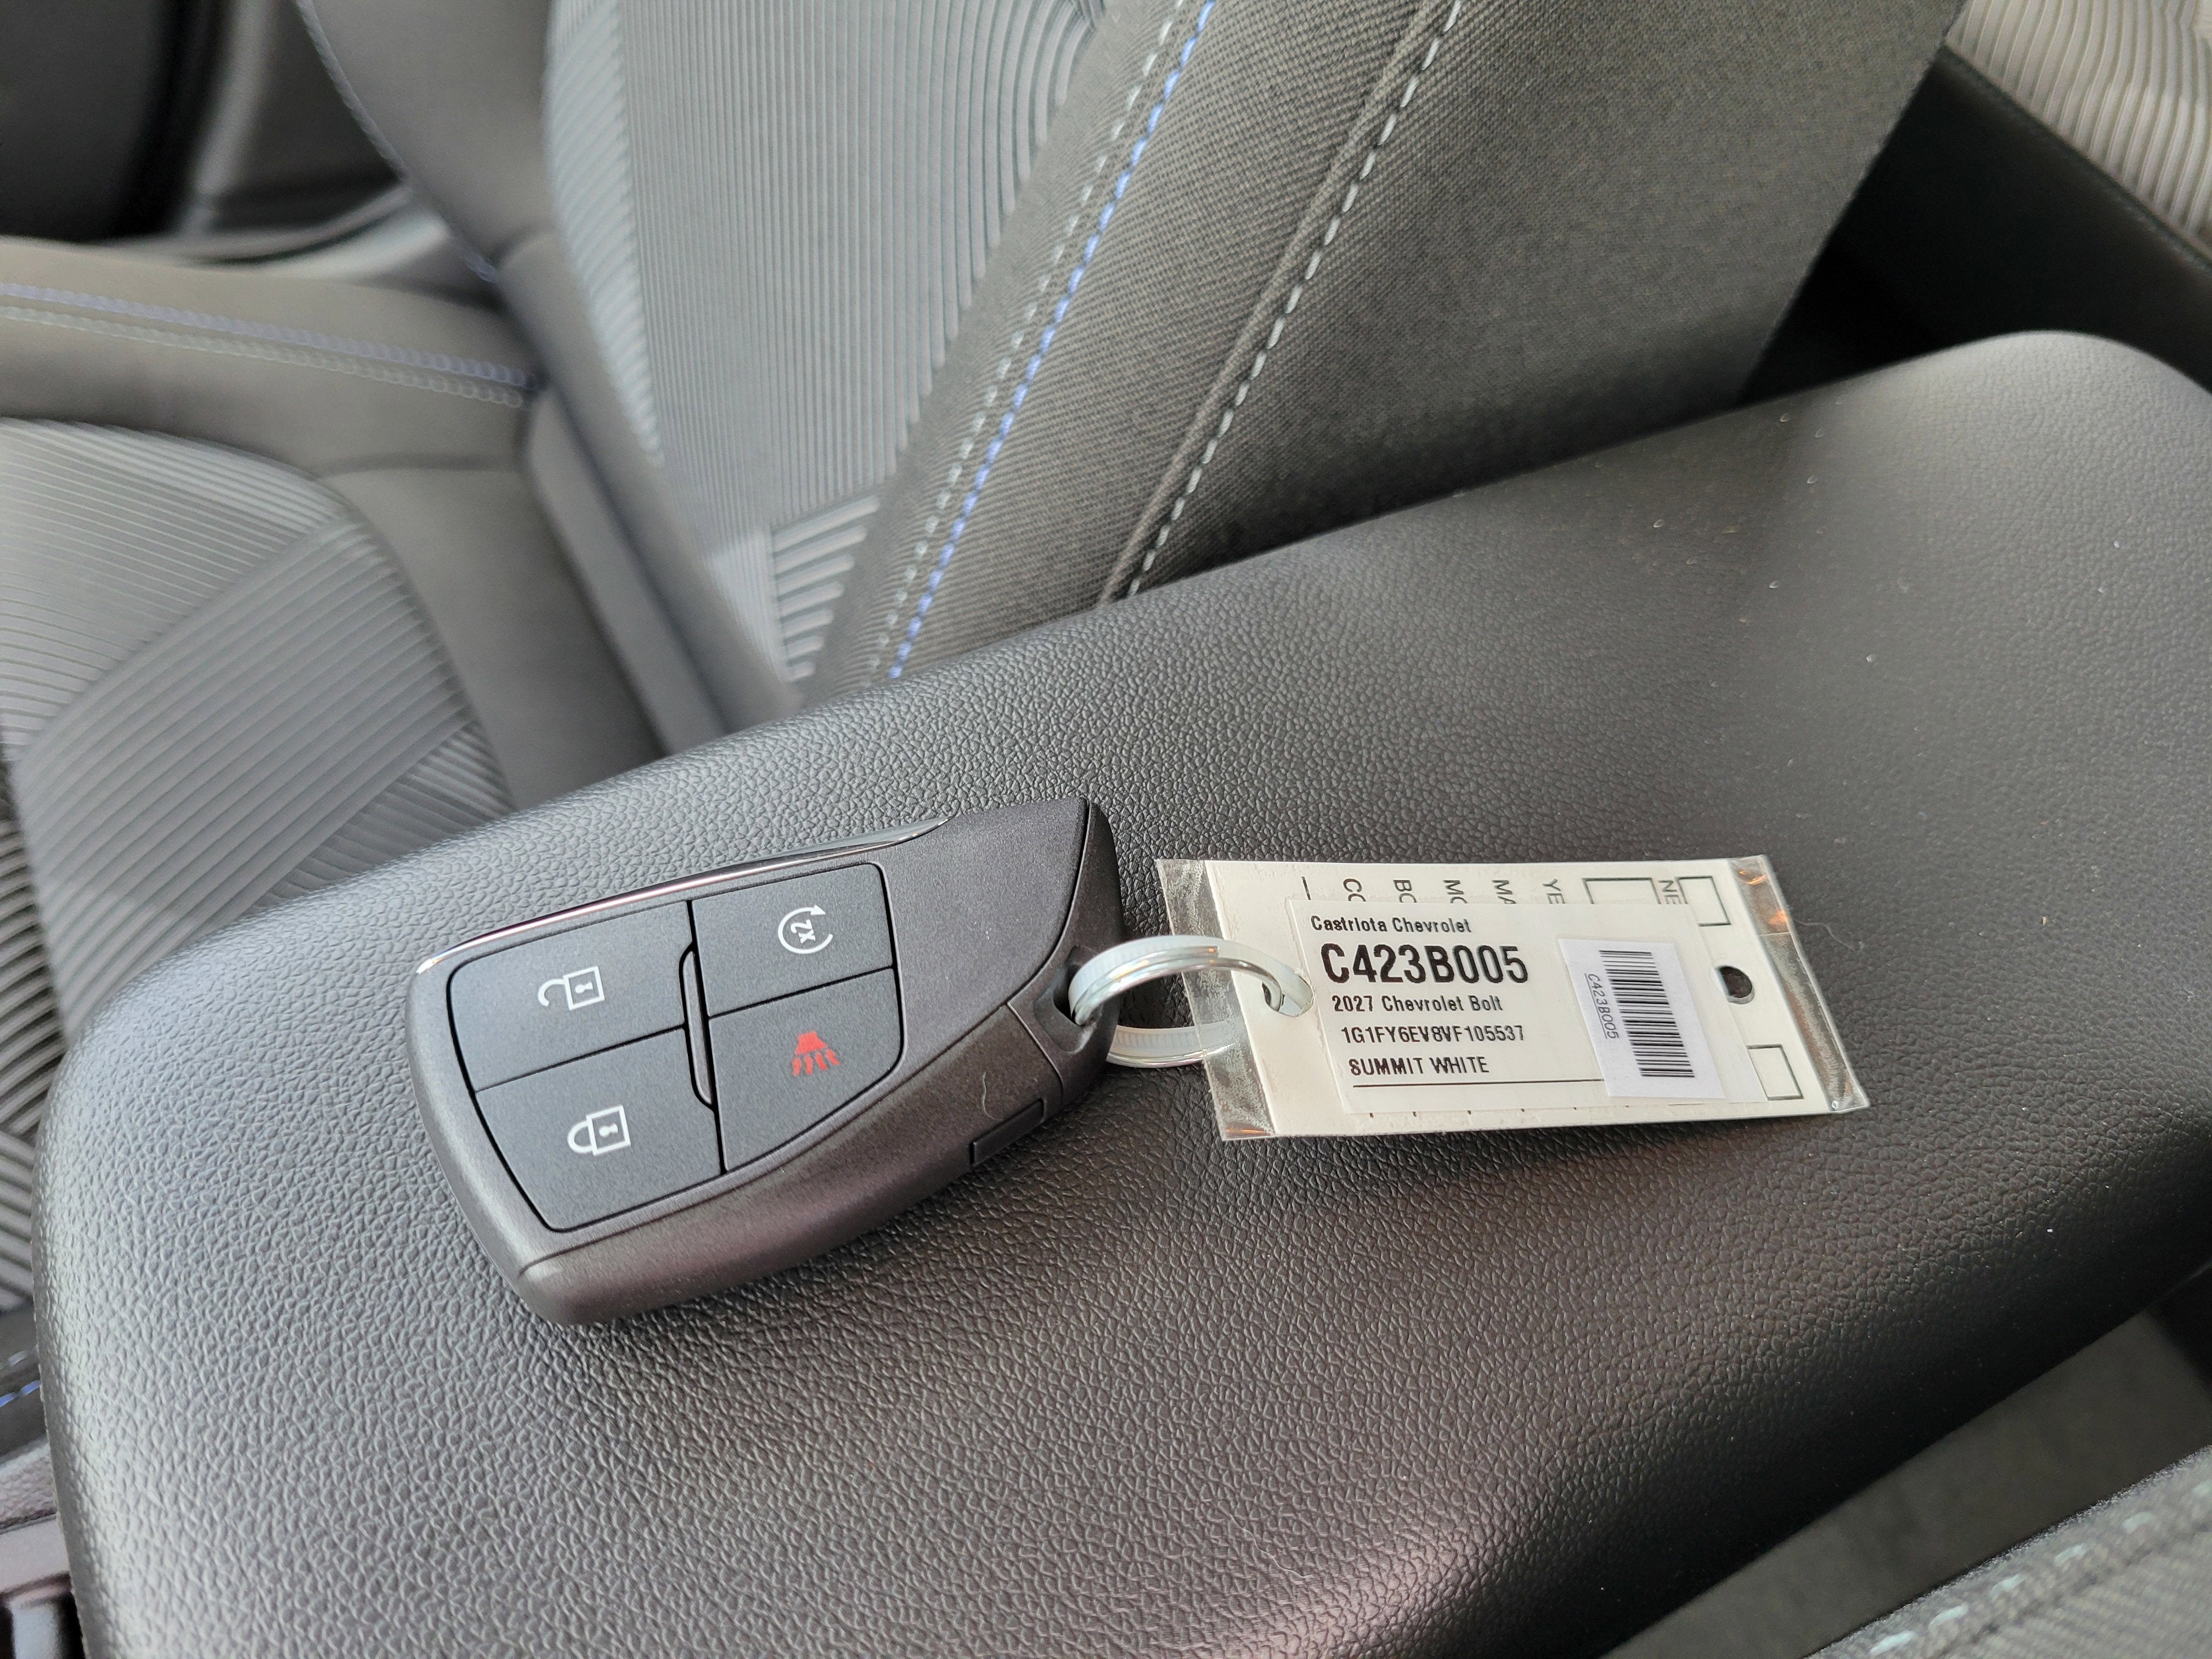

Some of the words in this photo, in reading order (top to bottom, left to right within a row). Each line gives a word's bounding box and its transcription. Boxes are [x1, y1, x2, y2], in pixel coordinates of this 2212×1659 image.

[1392, 917, 1471, 933] Chevrolet
[1321, 943, 1528, 984] C423B005
[1331, 995, 1373, 1012] 2027
[1382, 995, 1464, 1012] Chevrolet
[1469, 995, 1503, 1011] Bolt
[1587, 973, 1619, 1039] C423B005
[1341, 1024, 1524, 1043] 1G1FY6EV8VF105537
[1348, 1057, 1424, 1076] SUMMIT
[1429, 1056, 1489, 1074] WHITE
